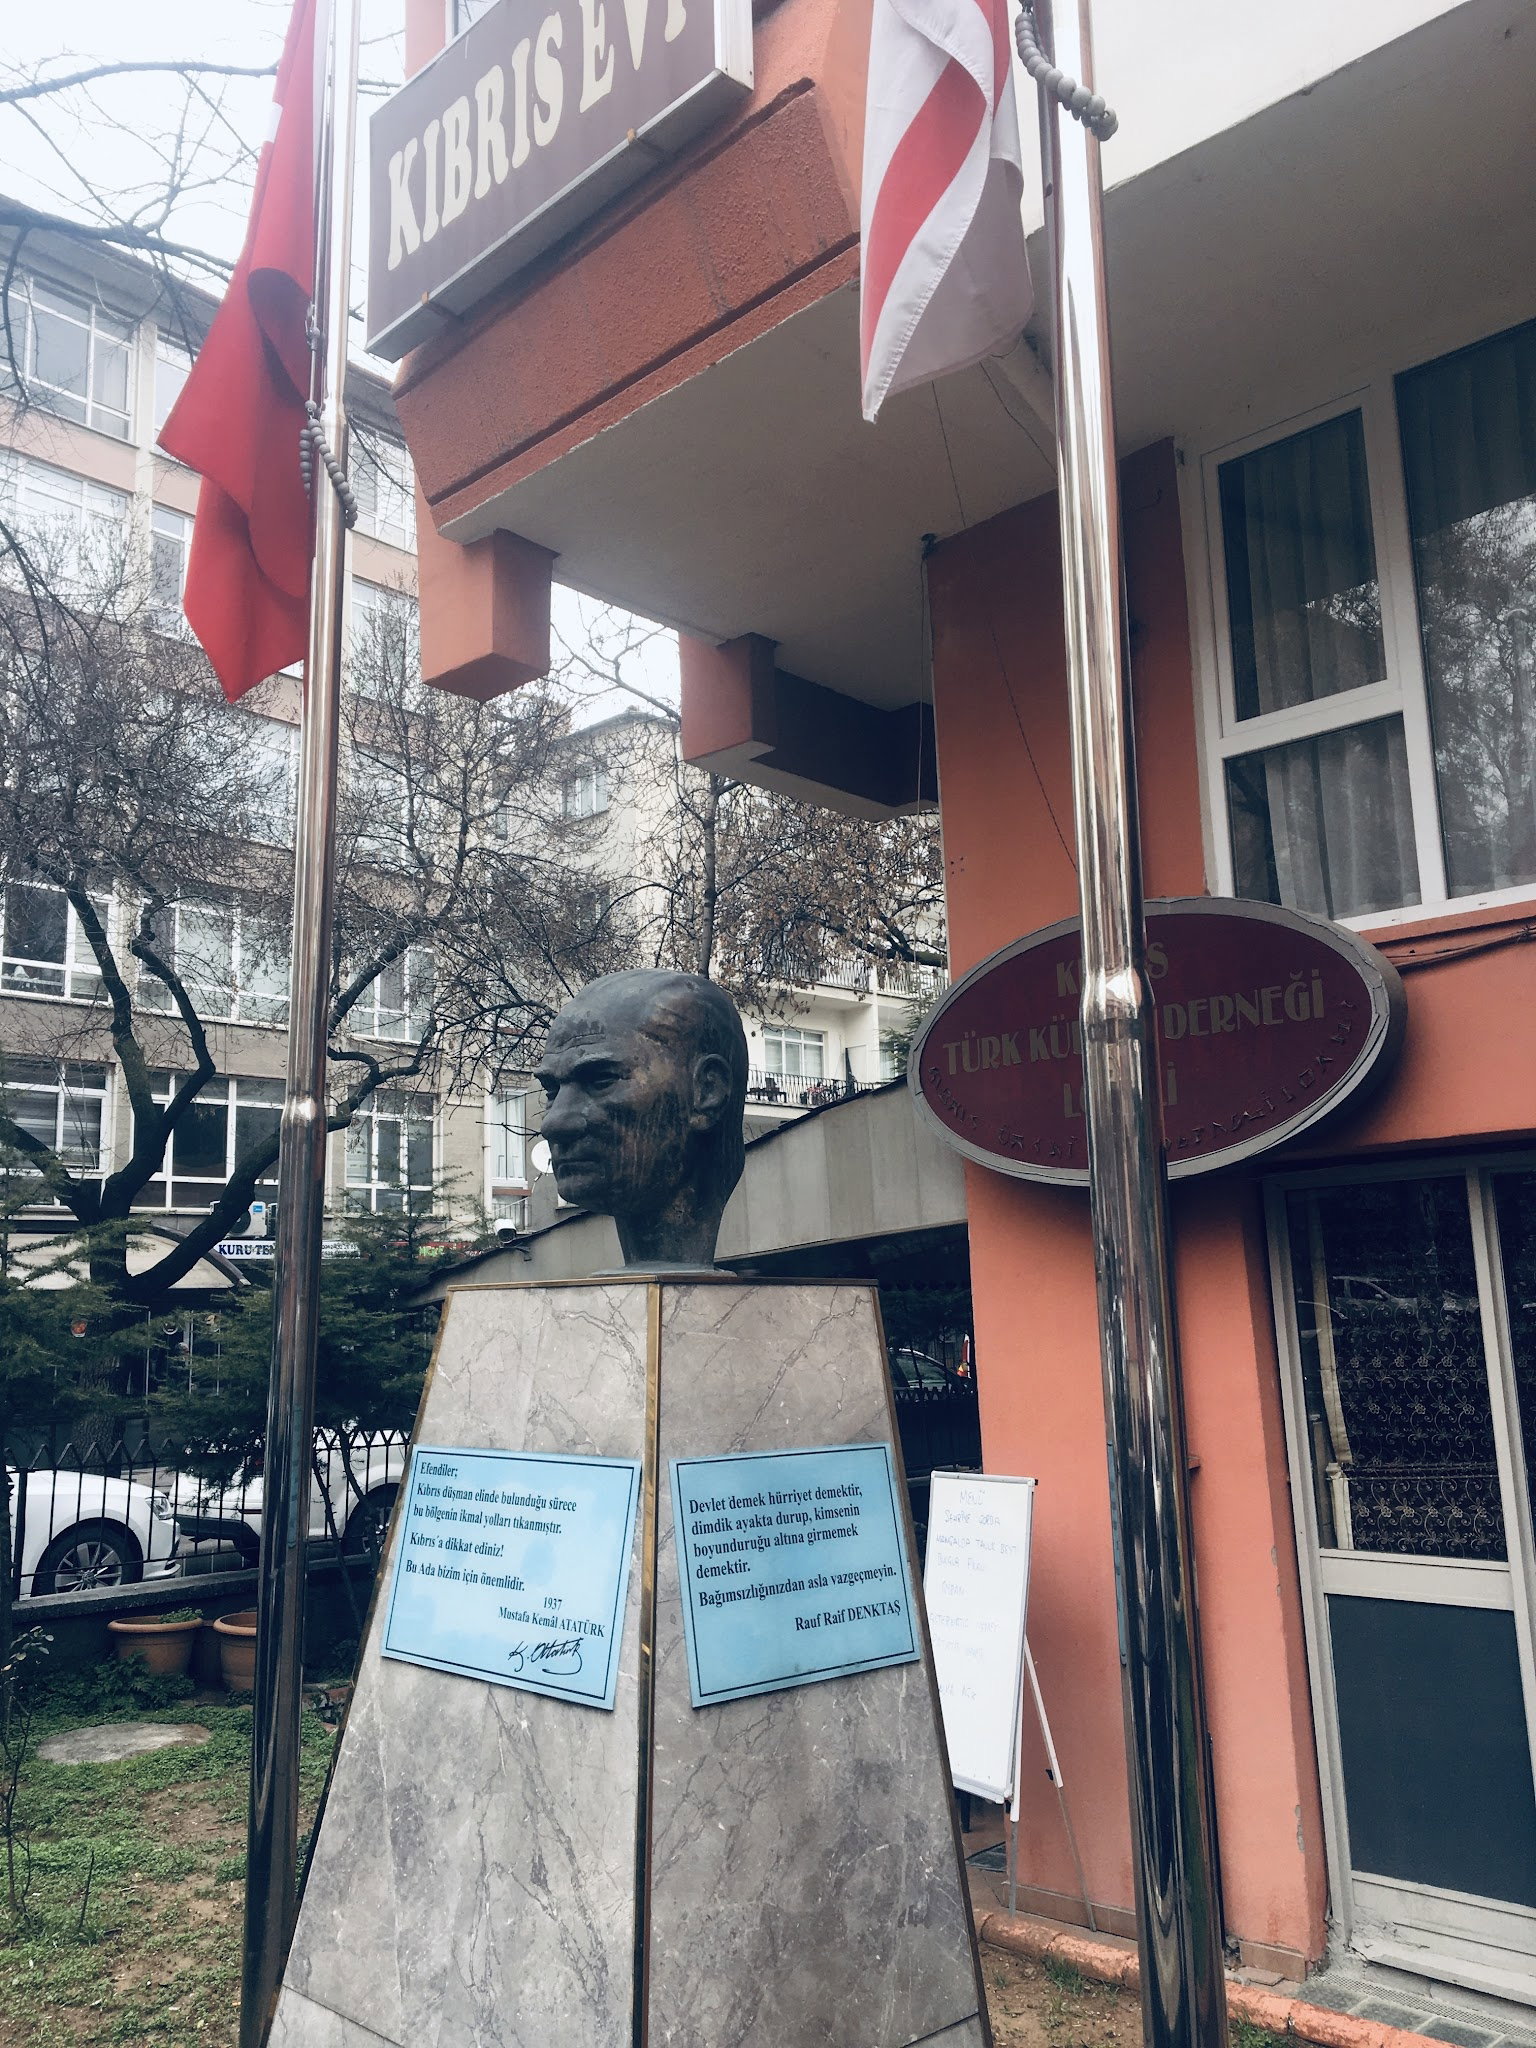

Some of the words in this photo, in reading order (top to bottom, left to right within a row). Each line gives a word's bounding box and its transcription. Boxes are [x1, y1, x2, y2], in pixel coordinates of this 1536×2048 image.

[388, 10, 564, 271] KIBRIS
[943, 1030, 1022, 1076] TÜRK
[1163, 968, 1325, 1040] DERNEĞİ
[218, 1244, 252, 1255] KURU
[420, 1461, 458, 1478] Efendiler;
[417, 1482, 441, 1497] Kıbrıs
[442, 1486, 473, 1502] düşman
[475, 1489, 500, 1504] elinde
[501, 1491, 547, 1511] bulunduğu
[548, 1497, 577, 1512] sürece
[689, 1497, 726, 1514] Devlet
[728, 1492, 766, 1510] demek
[768, 1484, 813, 1505] hürriyet
[815, 1483, 863, 1500] demektir,
[413, 1504, 423, 1517] bu
[425, 1505, 458, 1522] bölgenin
[459, 1509, 483, 1524] ikmal
[484, 1512, 511, 1528] yolları
[513, 1516, 562, 1535] tıkanmıştır.
[691, 1517, 733, 1535] dimdik
[736, 1513, 773, 1533] ayakta
[776, 1511, 812, 1526] durup,
[814, 1503, 860, 1521] kimsenin
[445, 1537, 473, 1553] dikkat
[474, 1542, 504, 1557] ediniz!
[693, 1535, 771, 1559] boyunduruğu
[774, 1532, 804, 1547] altına
[807, 1523, 859, 1546] girmemek
[405, 1559, 418, 1573] Bu
[419, 1562, 436, 1577] Ada
[437, 1564, 461, 1581] bizim
[462, 1568, 478, 1585] için
[480, 1571, 525, 1591] önemlidir.
[696, 1559, 751, 1579] demektir.
[699, 1579, 805, 1608] Bağımsızlığınızdan
[808, 1573, 828, 1589] asla
[830, 1564, 897, 1587] vazgeçmeyin.
[543, 1596, 562, 1611] 1937
[795, 1613, 821, 1631] Rauf
[823, 1609, 846, 1626] Raif
[848, 1599, 901, 1622] DENKTAŞ
[499, 1606, 530, 1623] Mustafa
[531, 1612, 558, 1628] Kemâl
[558, 1618, 605, 1638] ATATÜRK
